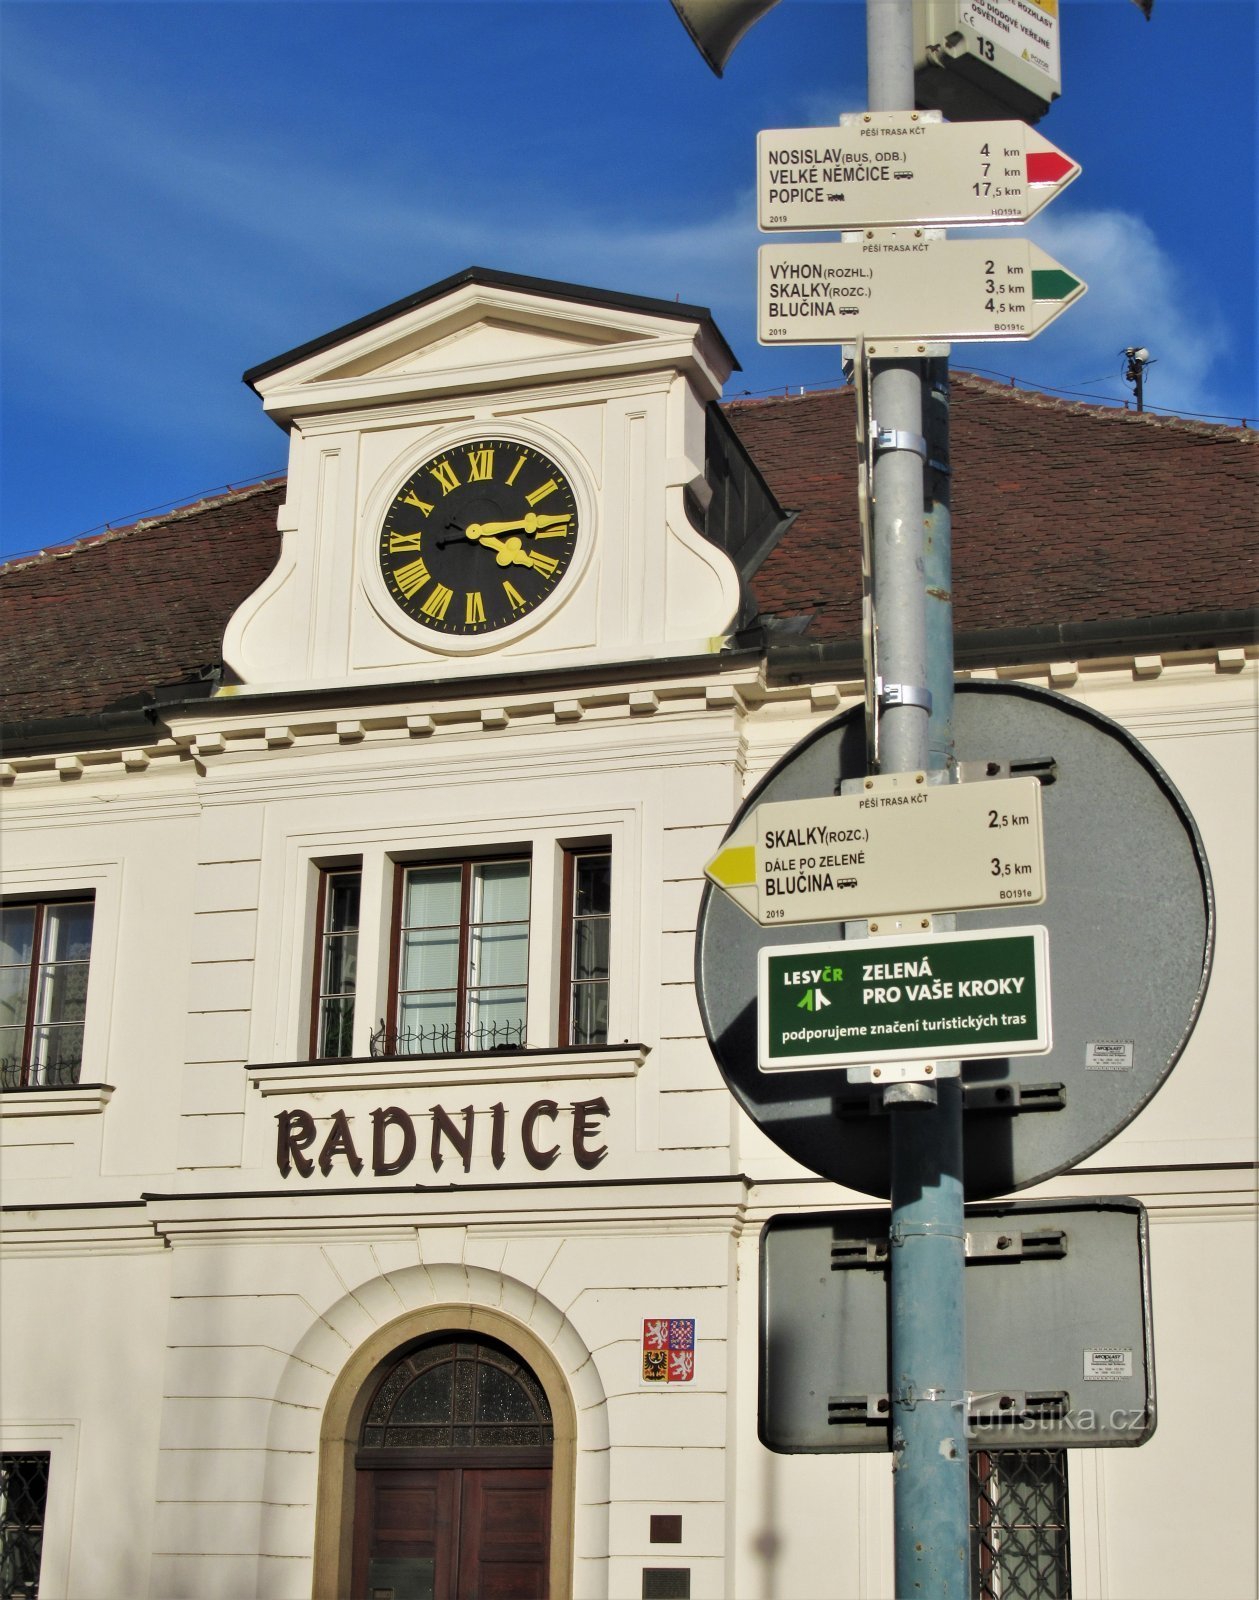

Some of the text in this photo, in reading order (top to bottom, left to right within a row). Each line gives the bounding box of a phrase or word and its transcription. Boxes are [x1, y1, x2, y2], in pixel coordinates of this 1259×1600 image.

[971, 3, 1010, 33] OSVĚTLENÍ
[977, 36, 994, 62] 13
[860, 126, 926, 137] PĚŠÍ TRASA KČT
[875, 151, 907, 164] ODB.)
[980, 143, 1020, 158] 4 km
[769, 161, 890, 185] VELKÉ NĚMČICE
[982, 163, 1021, 177] 7 km
[769, 187, 824, 205] POPICE
[972, 182, 1021, 200] 17,5 km
[769, 215, 787, 223] 2019
[863, 242, 929, 253] PĚŠÍ TRASA KČT
[984, 260, 1024, 274] 2 km
[985, 278, 1025, 295] 3,5 km
[769, 298, 836, 318] BLUČINA
[984, 298, 1026, 314] 4,5 km
[768, 328, 787, 336] 2019
[994, 323, 1025, 331] BO191c
[467, 449, 495, 483] XII
[859, 794, 928, 809] PĚŠÍ TRASA KČT
[987, 810, 1030, 829] 2,5 km
[765, 852, 866, 873] DÁLE PO ZELENÉ
[990, 858, 1032, 877] 3,5 km
[765, 871, 834, 896] BLUČINA
[999, 890, 1033, 900] BO191e
[766, 909, 785, 919] 2019
[862, 956, 933, 982] ZELENÁ
[862, 977, 1025, 1006] PRO VAŠE KROKY
[781, 1013, 1027, 1045] podporujeme značení turistických tras
[274, 1096, 611, 1179] RADNICE
